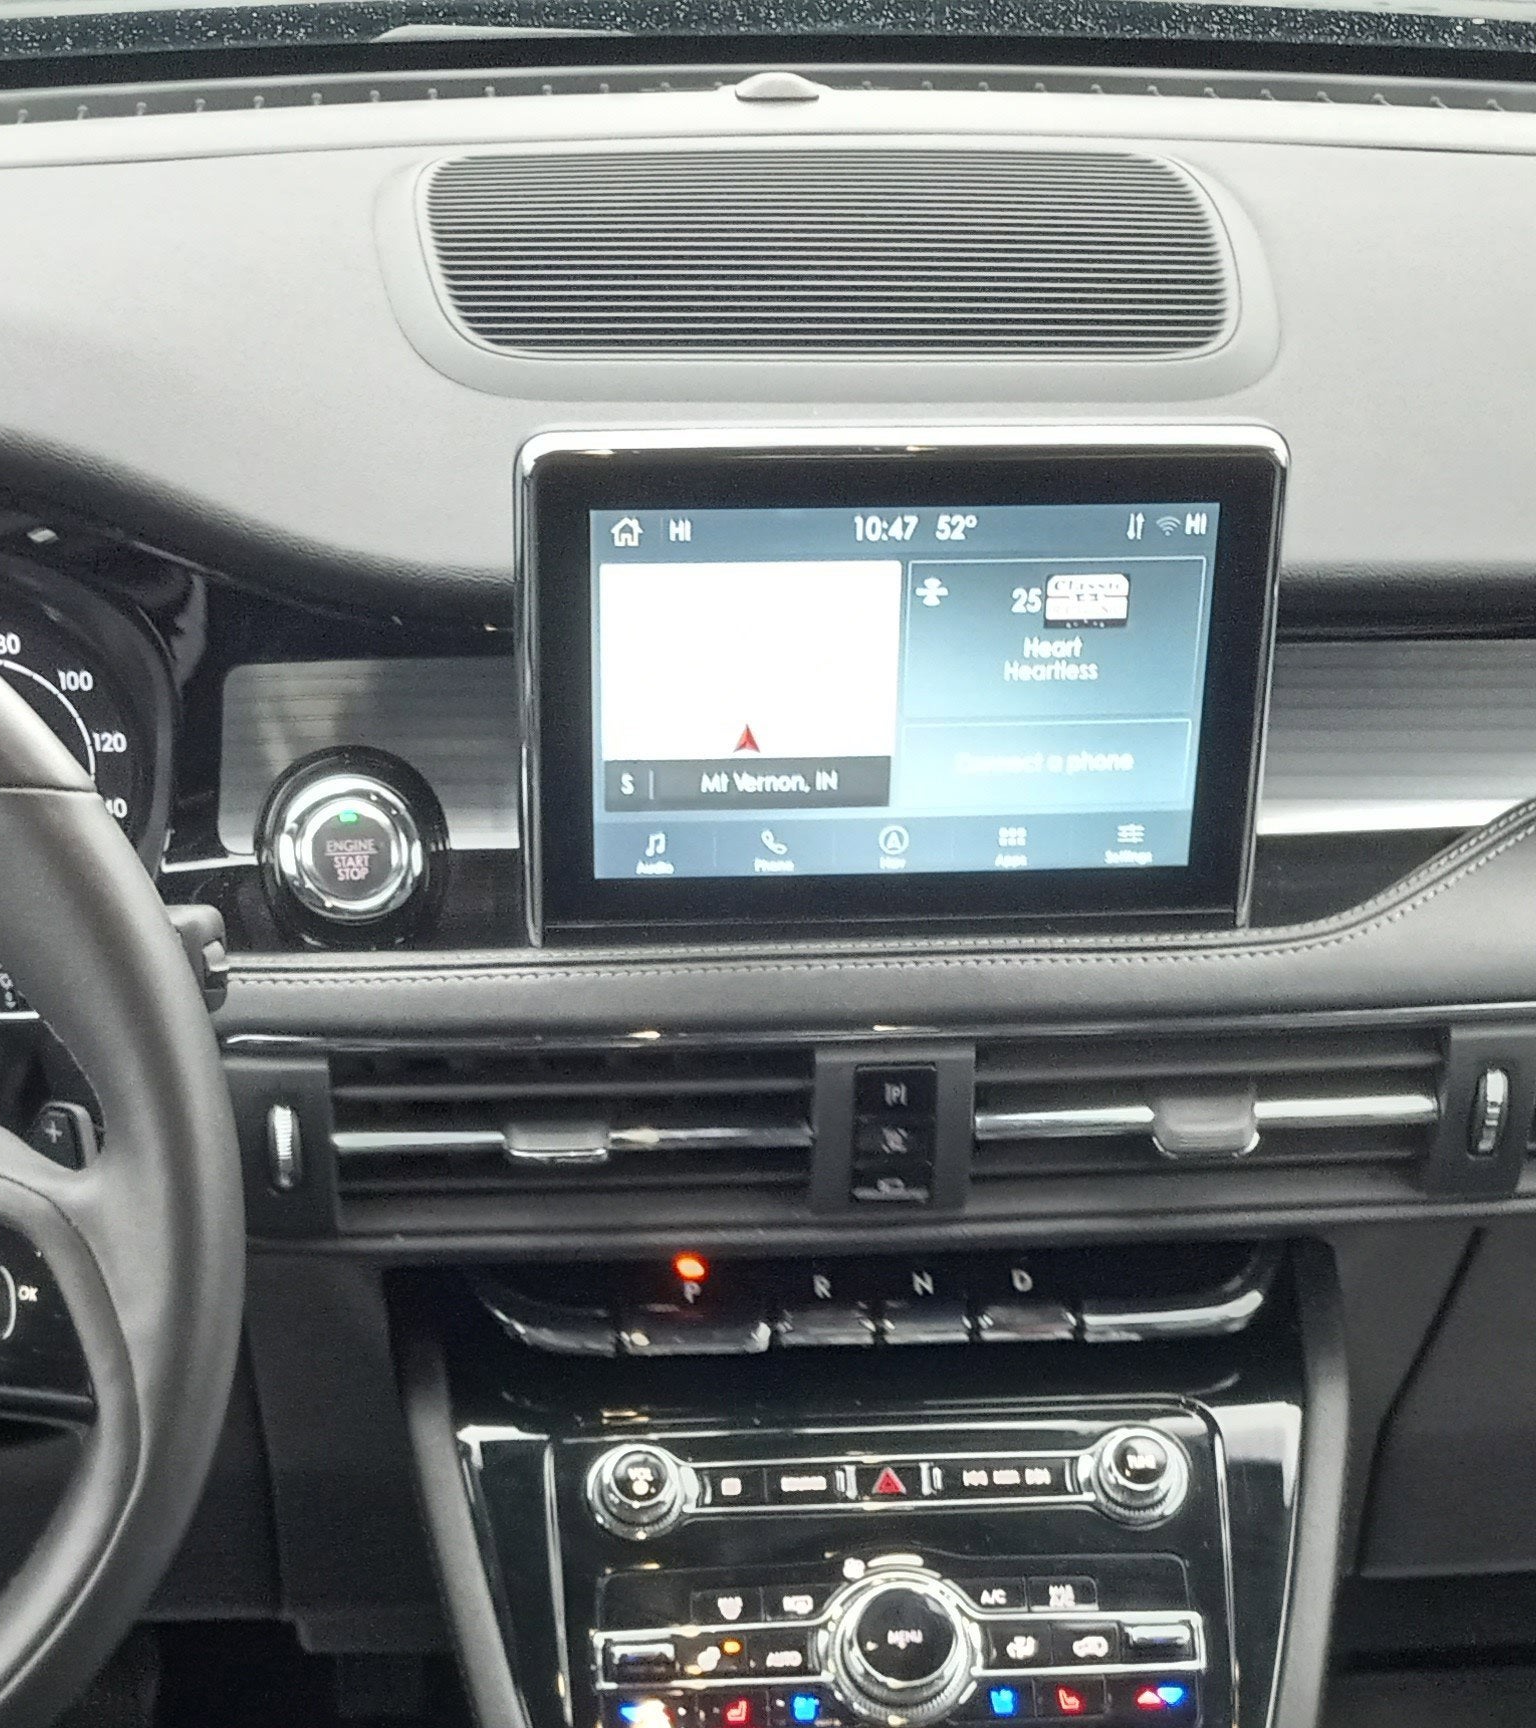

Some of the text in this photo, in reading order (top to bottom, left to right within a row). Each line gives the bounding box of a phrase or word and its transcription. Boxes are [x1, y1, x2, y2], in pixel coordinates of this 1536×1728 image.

[669, 519, 692, 542] HI
[853, 514, 978, 542] 10:47 52°
[1185, 513, 1208, 535] HI
[1011, 588, 1042, 613] 25
[1023, 636, 1083, 659] Heart
[57, 670, 93, 691] 100
[1004, 661, 1098, 682] Heartless
[93, 732, 128, 753] 120
[621, 771, 634, 795] S
[815, 769, 839, 791] IN
[326, 838, 377, 852] ENGINE
[332, 855, 370, 868] START
[336, 867, 370, 881] STOP
[18, 1285, 38, 1302] OK
[683, 1268, 1033, 1304] P R N D
[981, 1590, 1007, 1605] A/C
